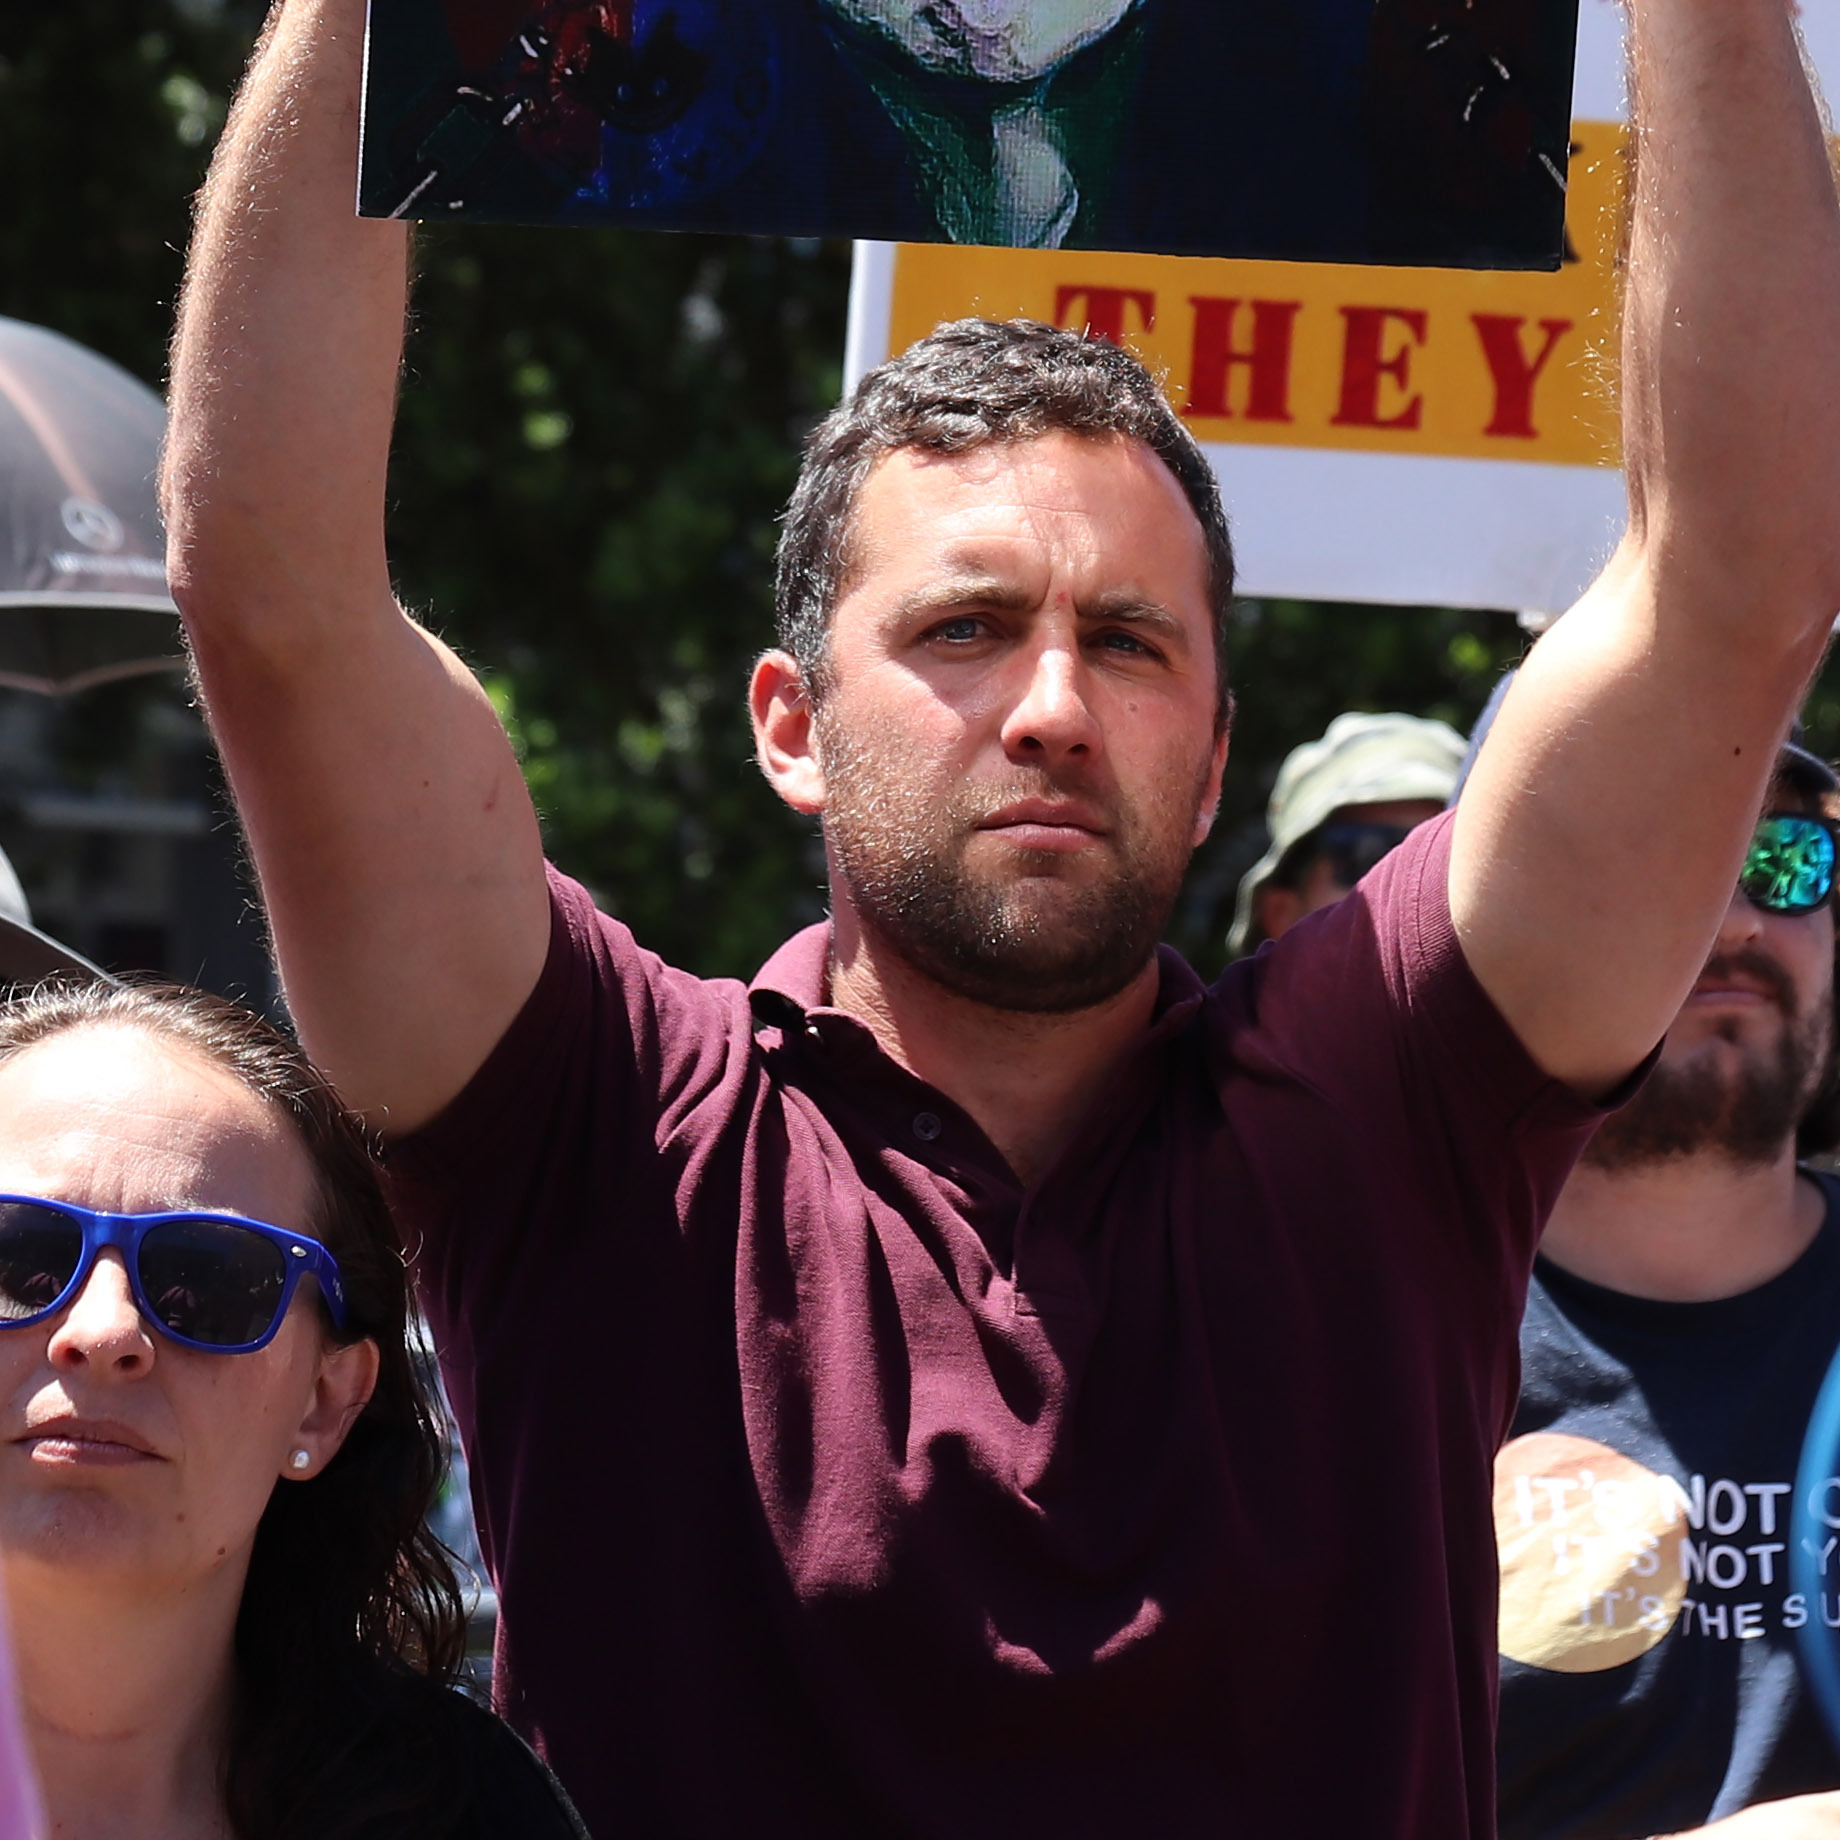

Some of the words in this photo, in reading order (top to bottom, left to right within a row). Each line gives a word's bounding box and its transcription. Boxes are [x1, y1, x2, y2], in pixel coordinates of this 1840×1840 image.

[1054, 284, 1574, 439] THEY
[1657, 1473, 1792, 1536] NOT
[1552, 1532, 1659, 1578] ITS
[1678, 1535, 1786, 1590] NOT
[1680, 1597, 1767, 1641] THE
